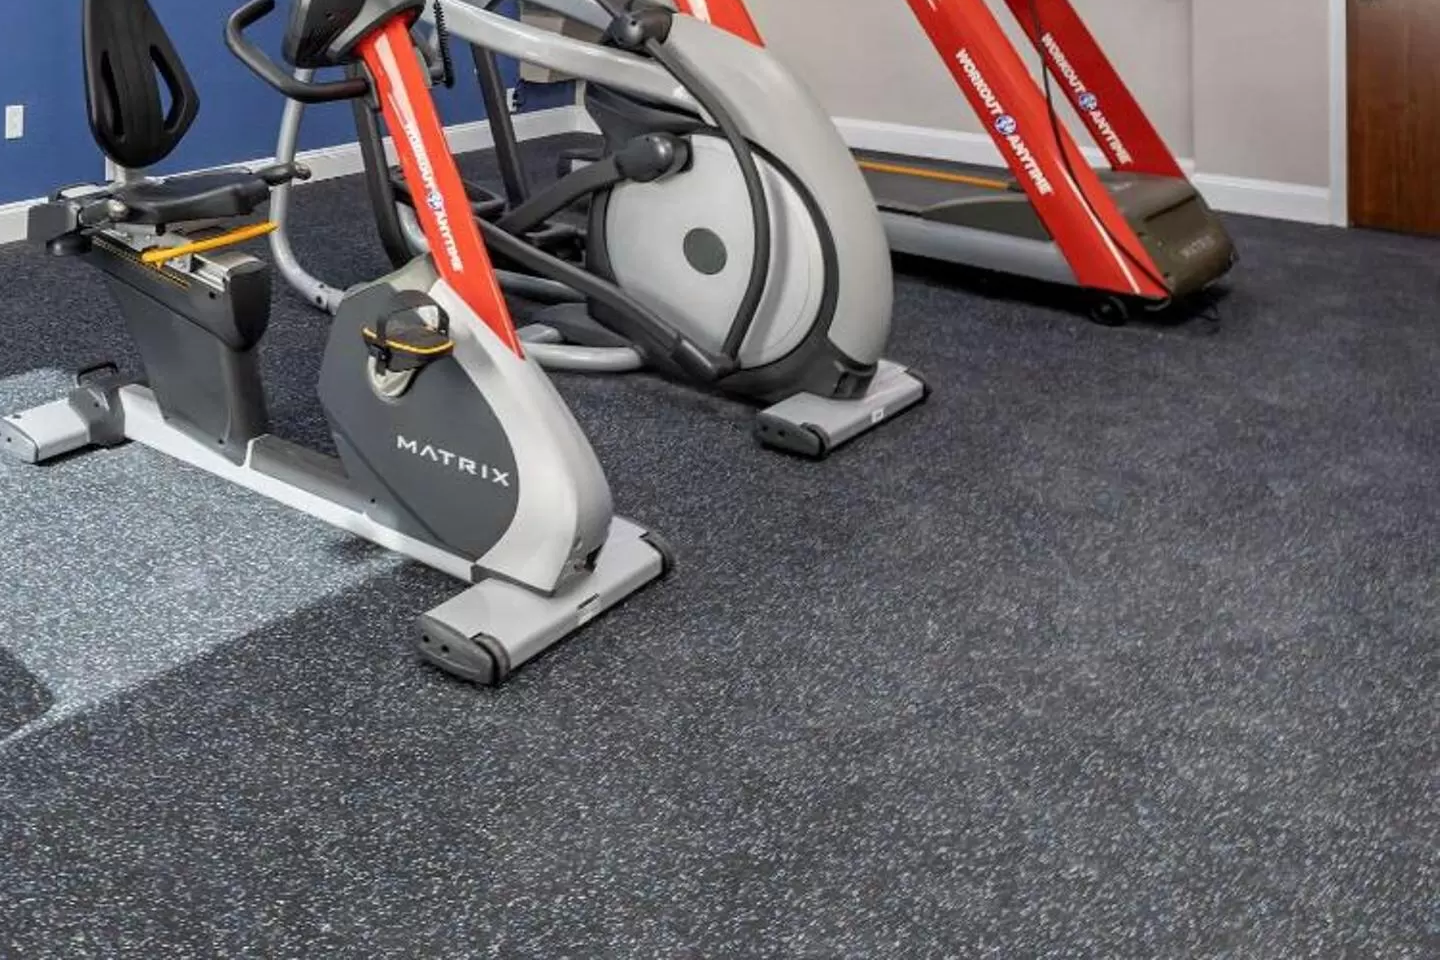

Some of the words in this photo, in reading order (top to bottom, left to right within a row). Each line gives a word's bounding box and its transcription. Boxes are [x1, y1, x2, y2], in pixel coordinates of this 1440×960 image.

[955, 48, 1004, 116] WORKOUT
[1006, 134, 1055, 195] ANYTIME
[1042, 31, 1086, 93] WORKOUT
[1089, 110, 1134, 164] ANYTIME
[433, 211, 464, 273] ANYTIME
[396, 434, 510, 487] MATRIX
